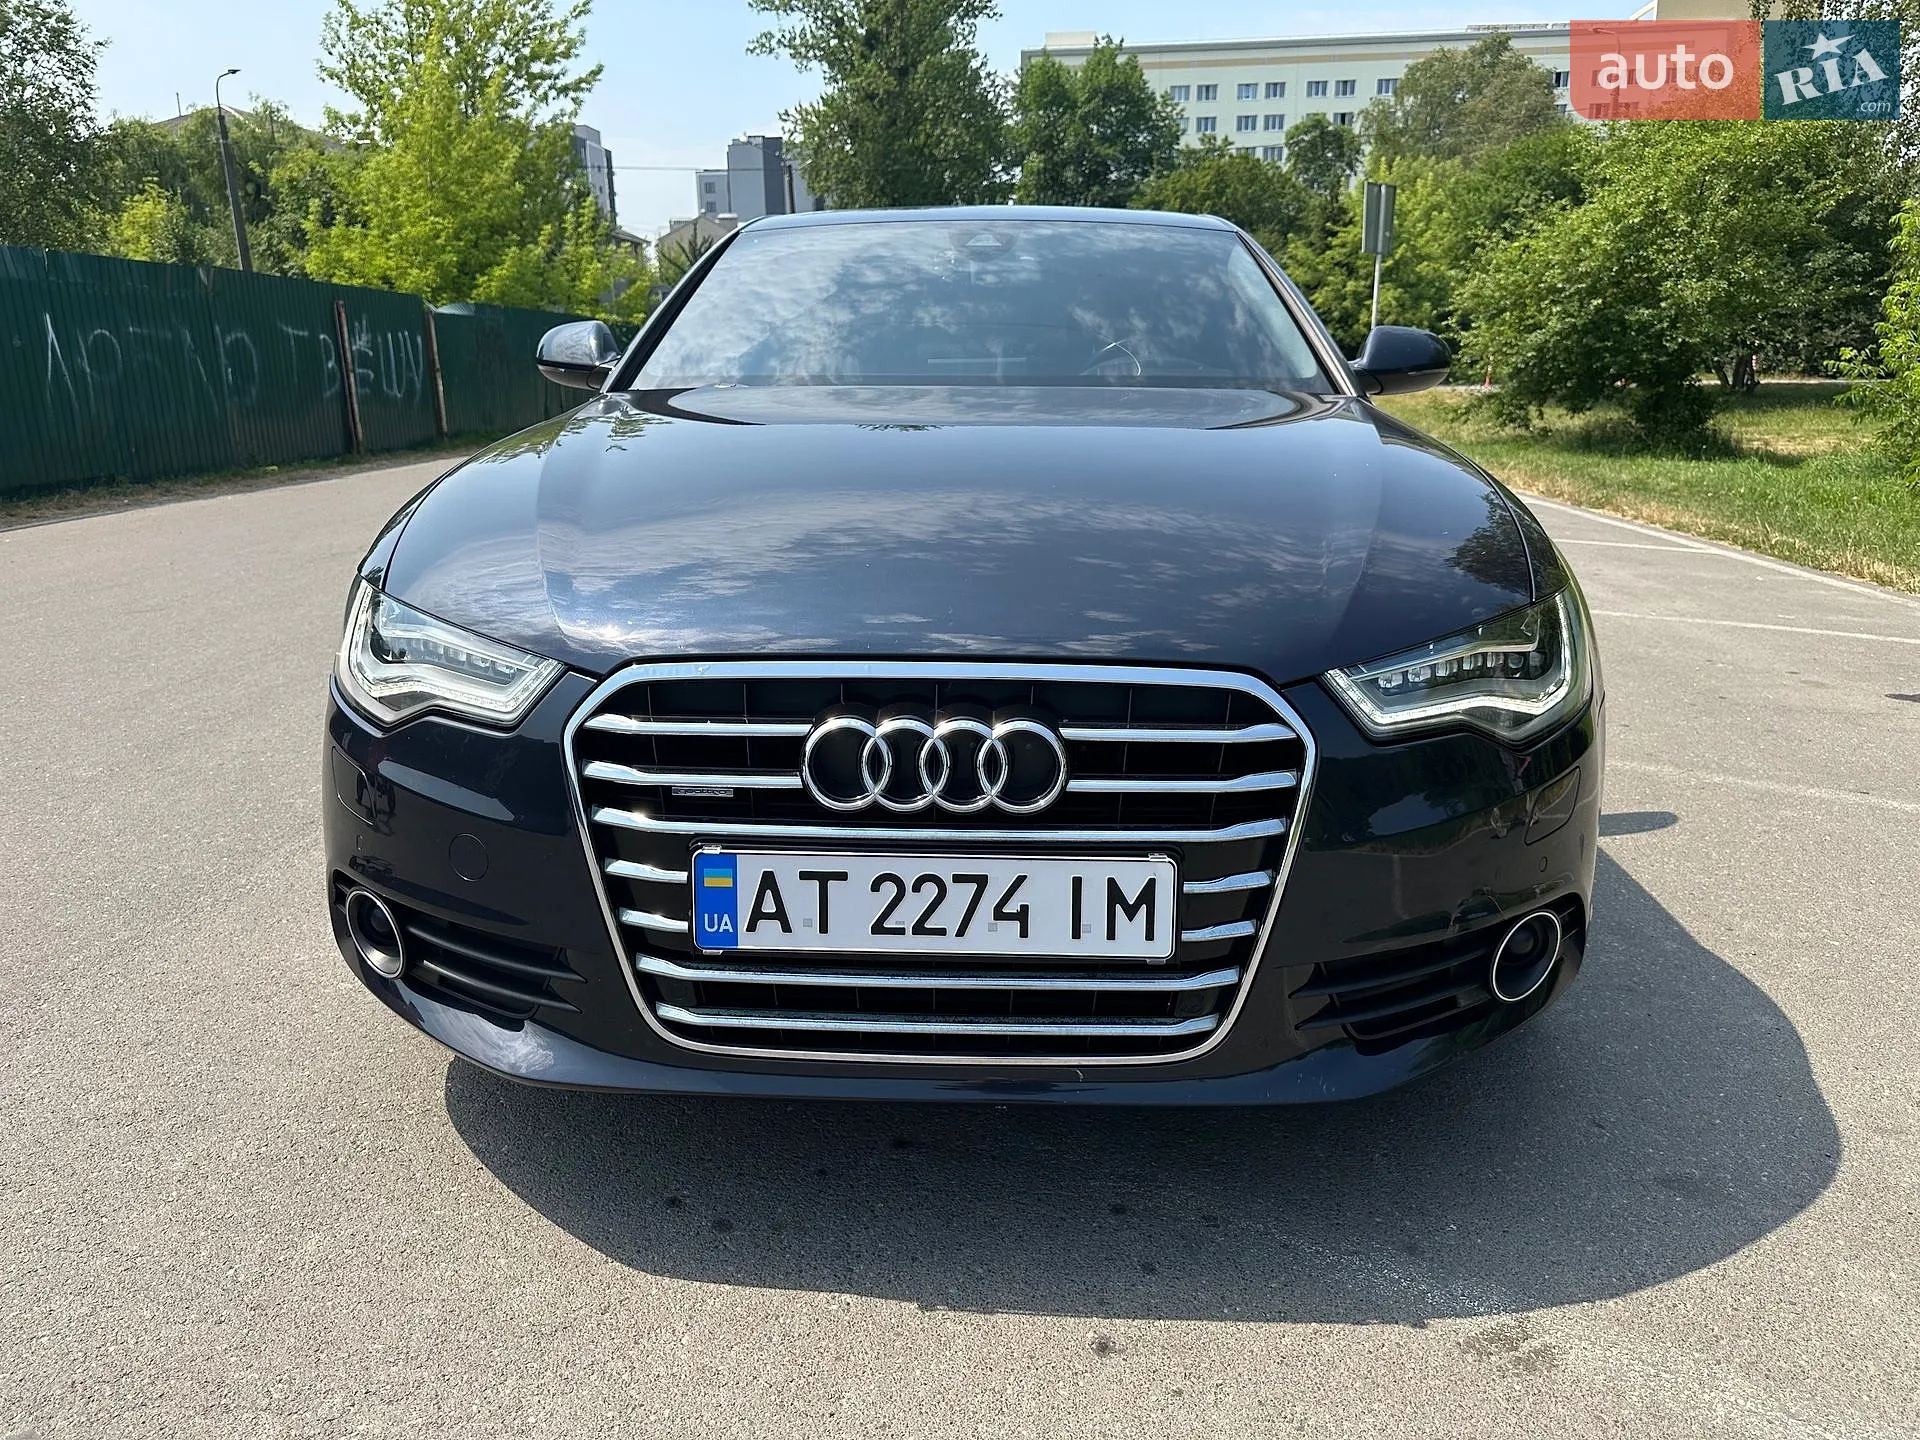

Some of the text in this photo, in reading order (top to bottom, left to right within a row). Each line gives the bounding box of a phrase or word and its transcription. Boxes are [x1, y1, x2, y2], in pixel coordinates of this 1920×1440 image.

[704, 912, 734, 933] UA
[744, 869, 1157, 942] AT 2274 IM
